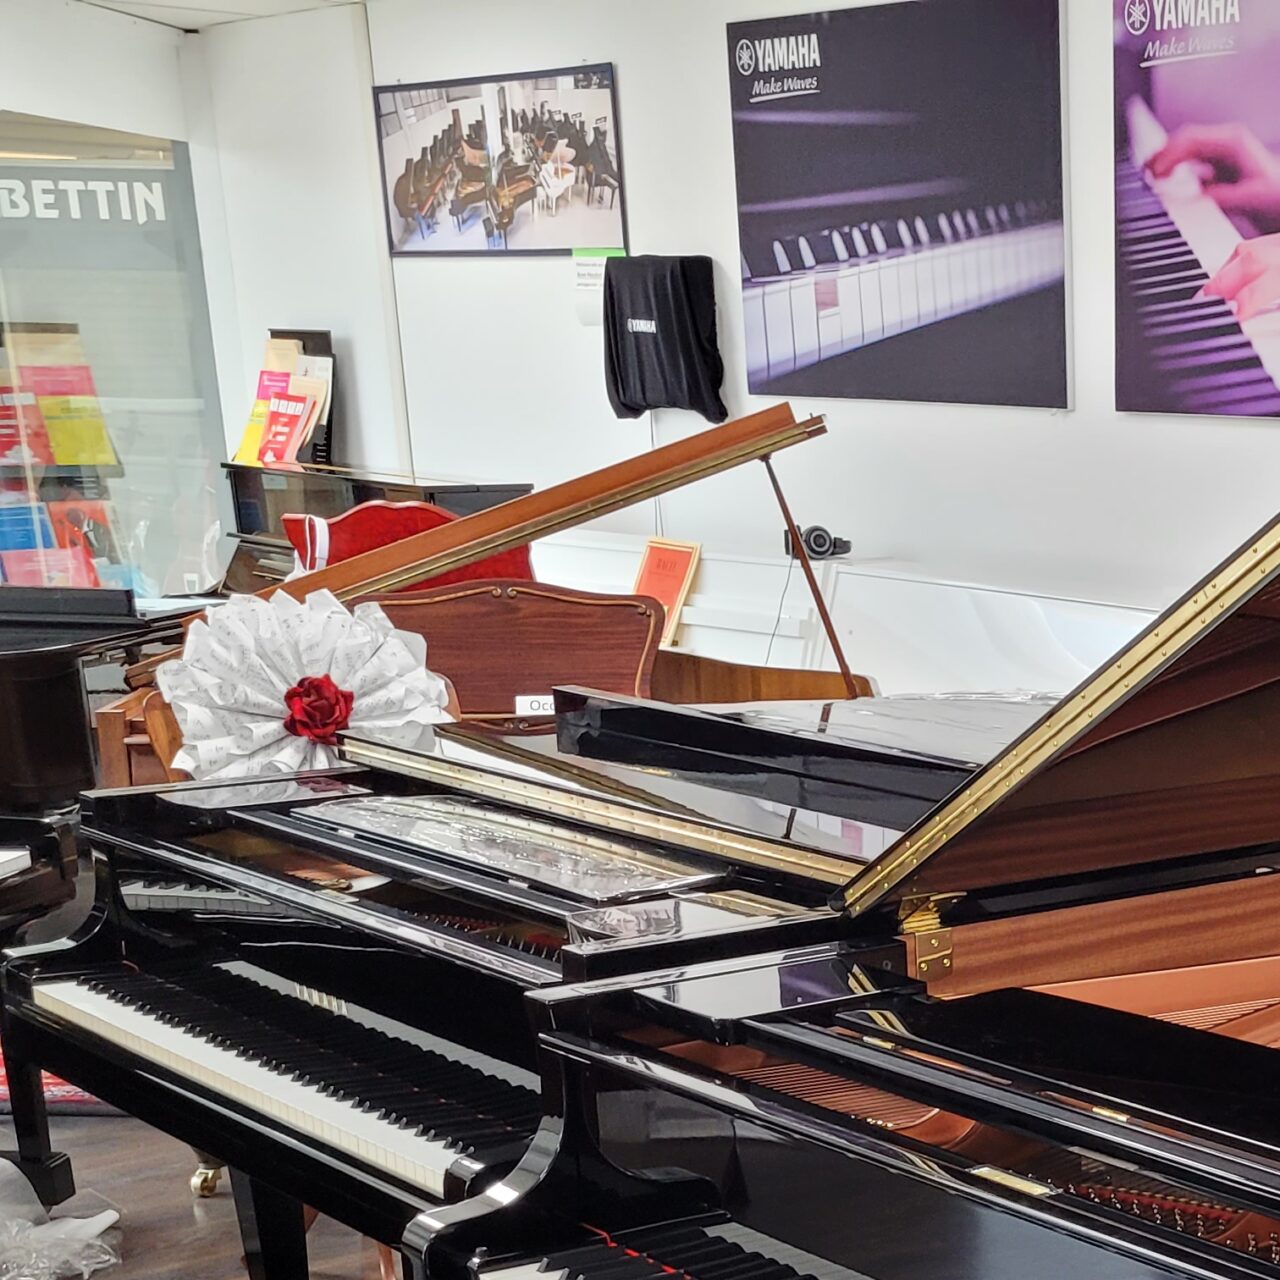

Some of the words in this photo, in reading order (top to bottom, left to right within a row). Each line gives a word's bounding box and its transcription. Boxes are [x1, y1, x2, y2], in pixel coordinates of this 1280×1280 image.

[1153, 0, 1240, 31] YAMAHA
[754, 33, 821, 72] YAMAHA
[1144, 37, 1185, 59] Make
[1188, 35, 1234, 53] Waves
[752, 77, 783, 95] Make
[784, 76, 818, 91] Waves
[0, 179, 166, 225] BETTIN
